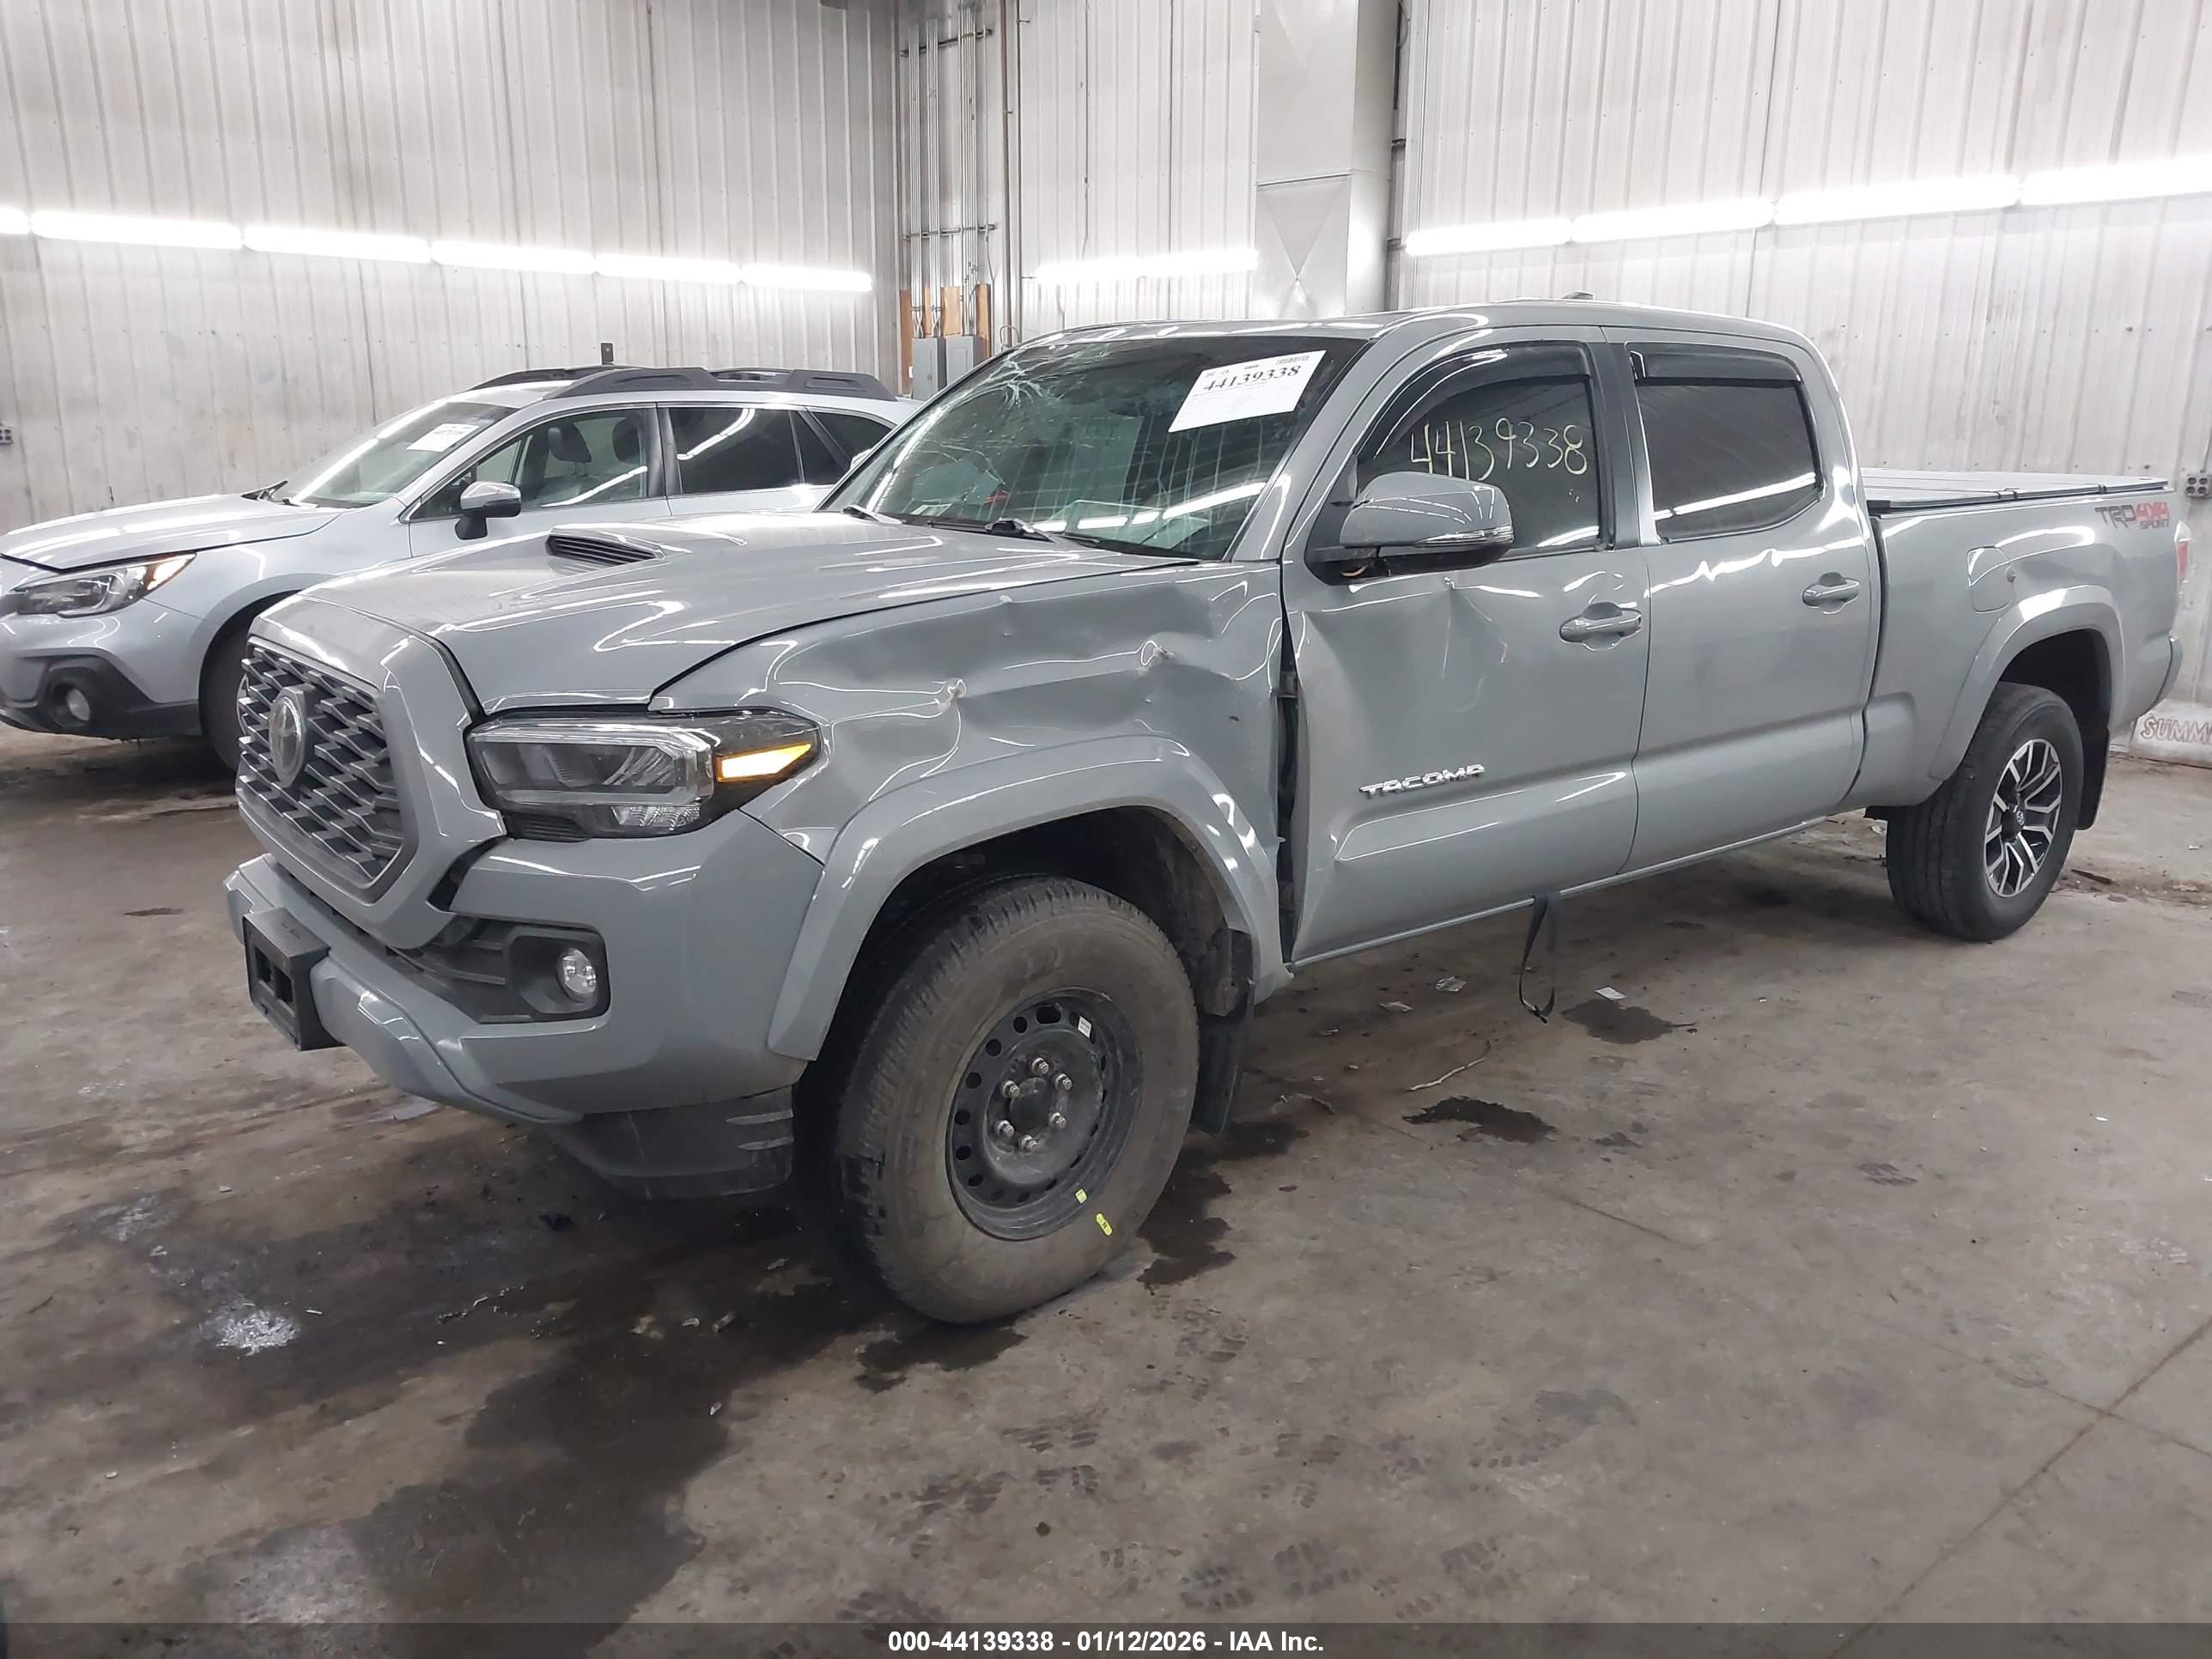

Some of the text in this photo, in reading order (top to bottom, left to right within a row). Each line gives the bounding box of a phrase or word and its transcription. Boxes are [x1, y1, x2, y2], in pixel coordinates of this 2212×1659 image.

[1203, 365, 1302, 391] 44139338
[1411, 417, 1588, 481] 44139338
[1359, 763, 1485, 798] TACOMA
